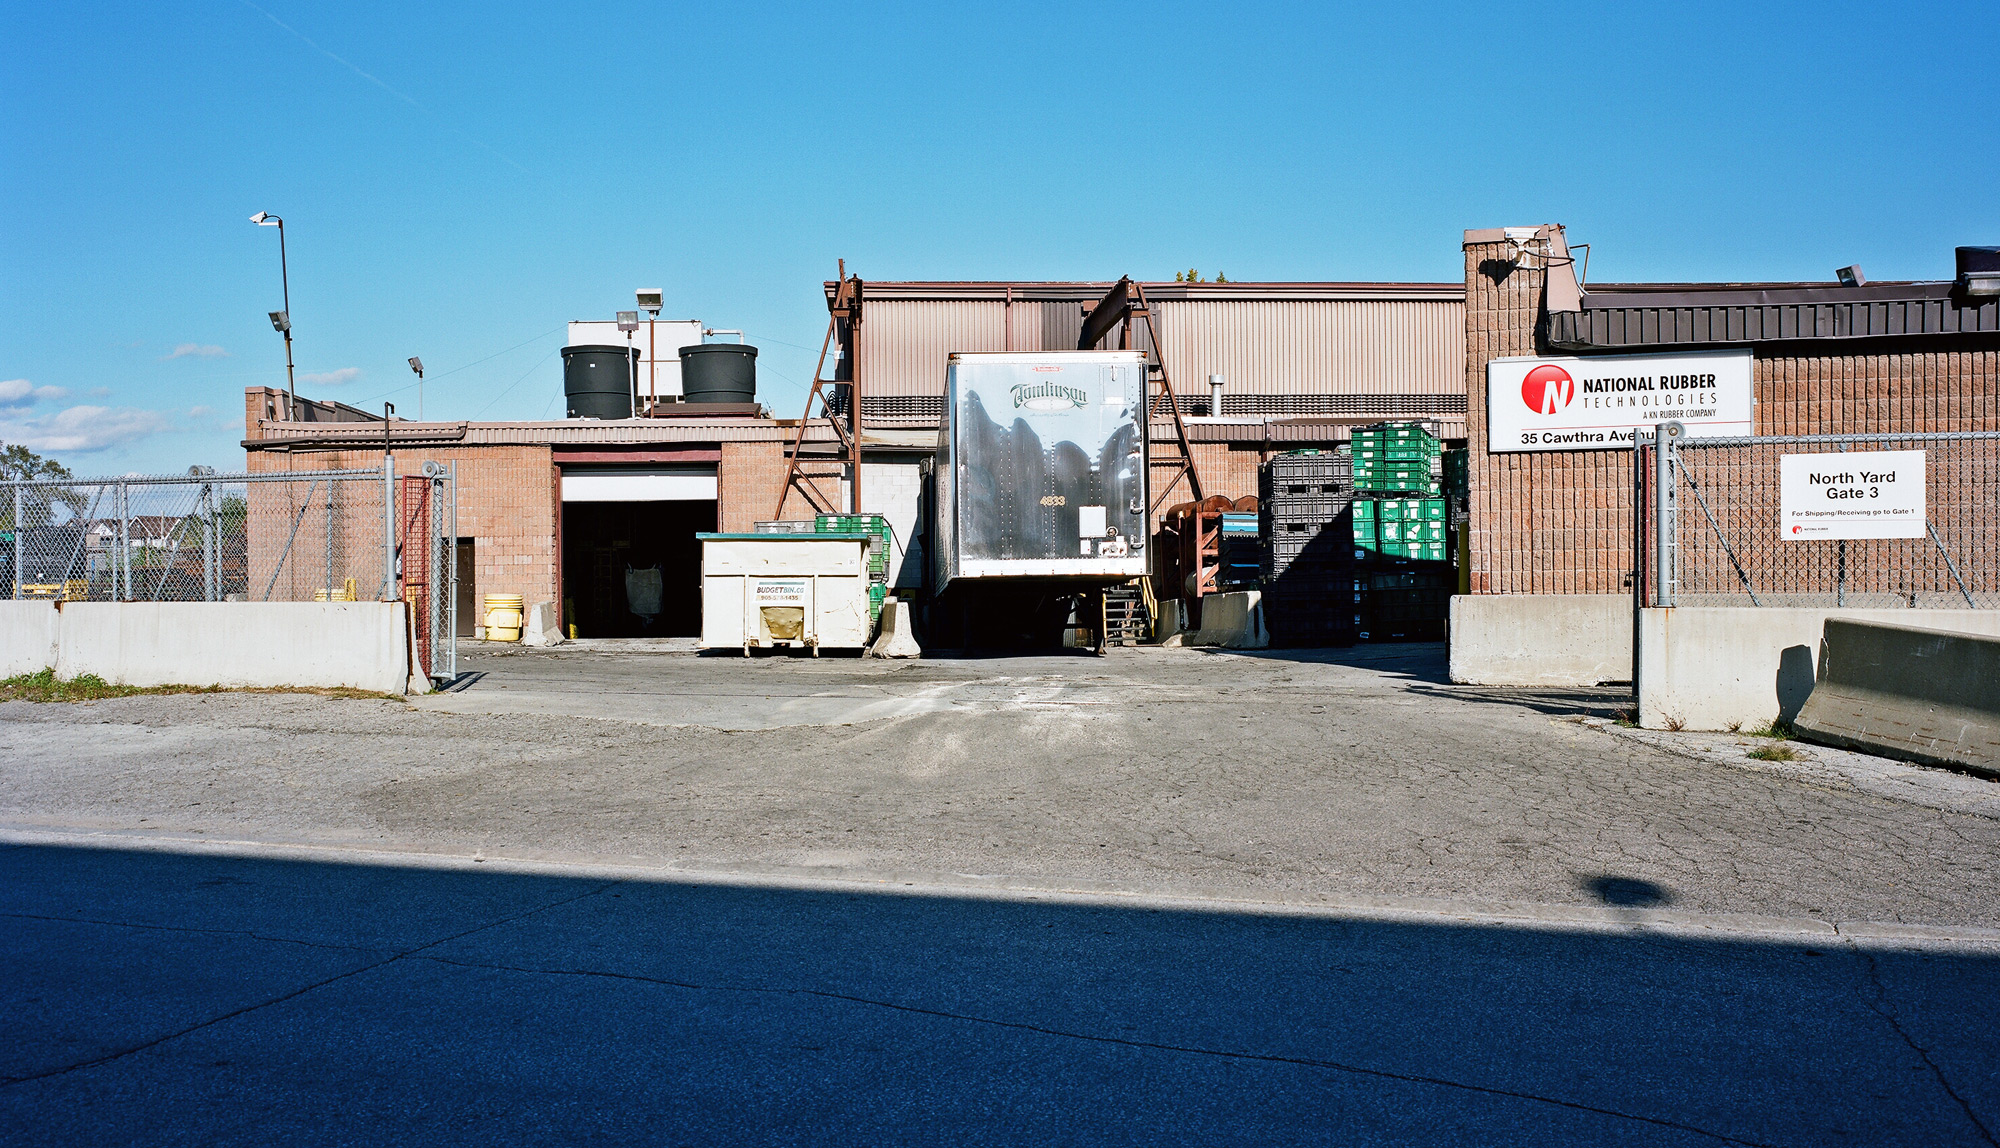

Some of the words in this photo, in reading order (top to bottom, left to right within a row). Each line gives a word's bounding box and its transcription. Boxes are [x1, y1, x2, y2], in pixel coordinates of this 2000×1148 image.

[1583, 376, 1655, 393] NATIONAL
[1660, 374, 1716, 390] RUBBER
[1010, 381, 1088, 409] Tomlinson
[1541, 381, 1570, 414] N
[1583, 392, 1717, 409] TECHNOLOGIES
[1642, 411, 1648, 419] A
[1649, 411, 1658, 419] KN
[1659, 409, 1685, 419] RUBBER
[1685, 408, 1717, 418] COMPANY
[1521, 433, 1538, 444] 35
[1542, 430, 1604, 444] Cawthra
[1608, 430, 1656, 441] Avenu
[1809, 472, 1854, 485] North
[1860, 470, 1896, 483] Yard
[1826, 486, 1864, 499] Gate
[1869, 486, 1879, 499] 3
[1804, 509, 1871, 518] Shipping/Receiving
[1872, 509, 1882, 517] go
